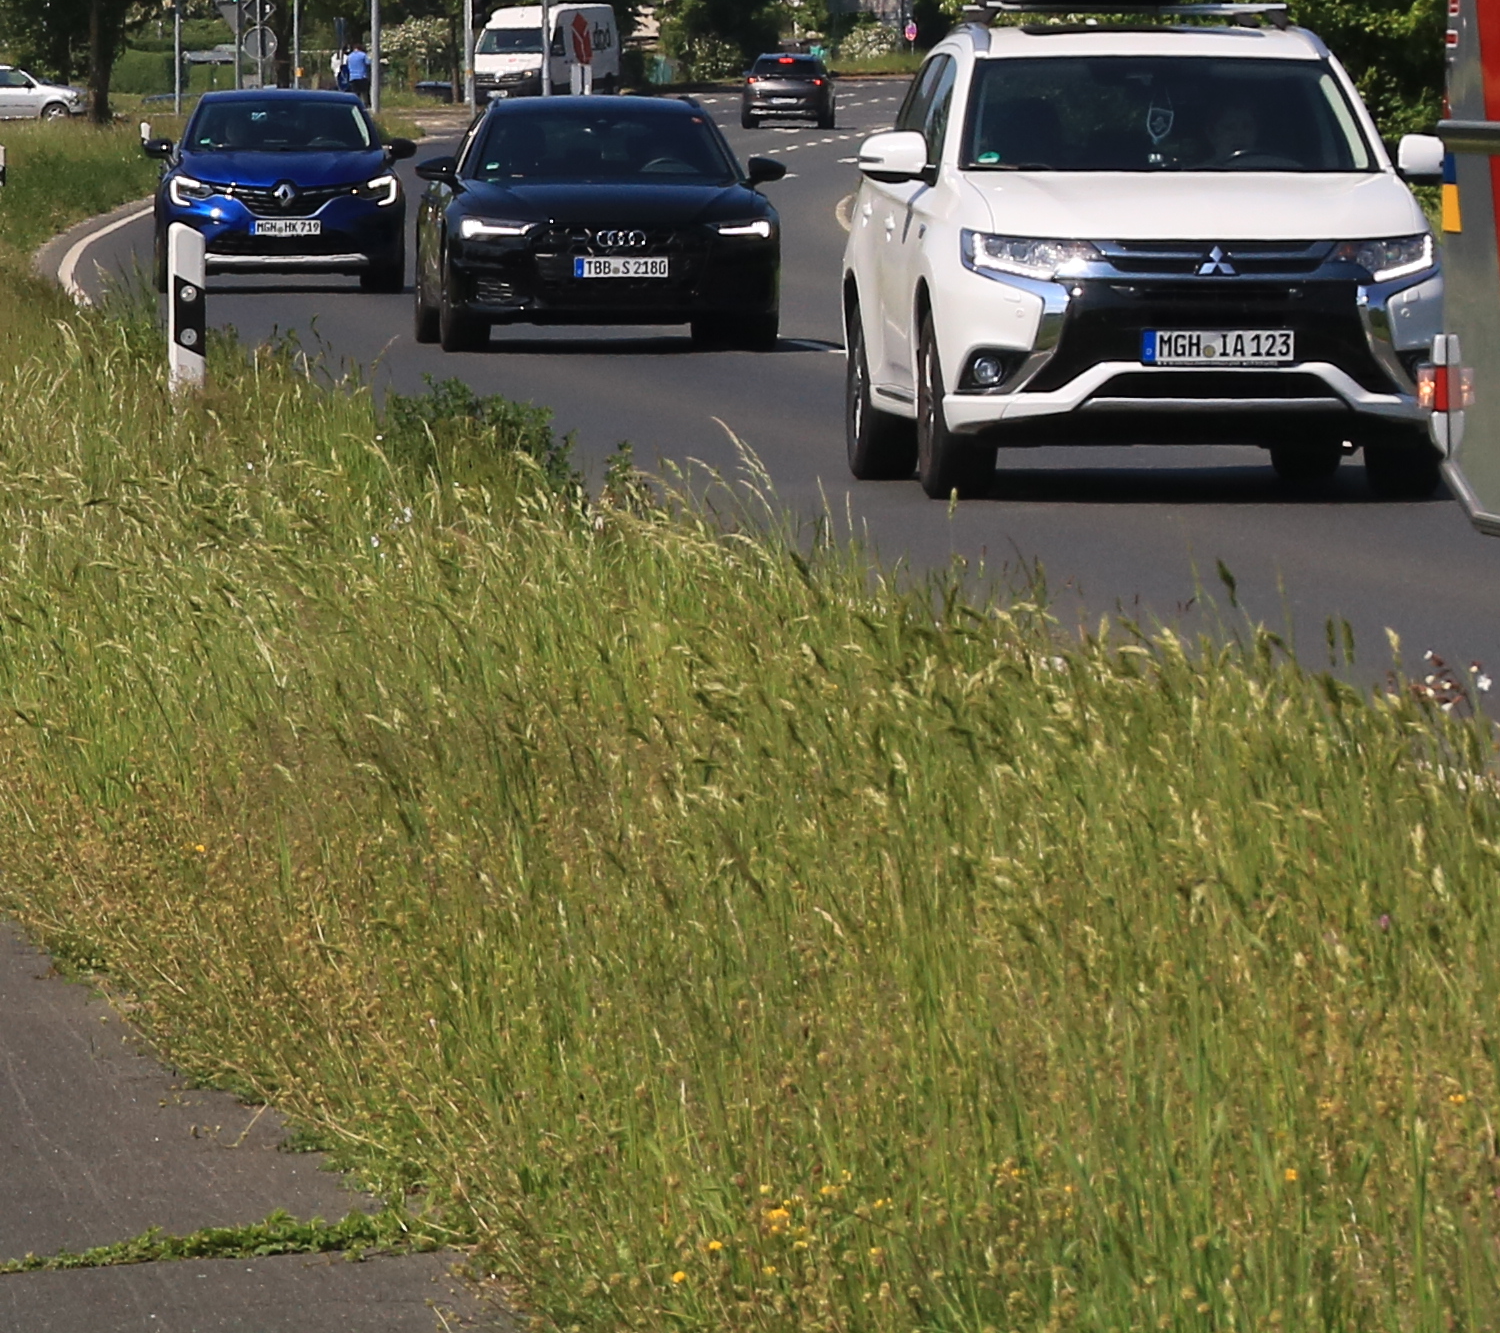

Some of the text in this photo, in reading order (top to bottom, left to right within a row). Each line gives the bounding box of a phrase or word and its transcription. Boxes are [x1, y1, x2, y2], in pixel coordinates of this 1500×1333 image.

[300, 221, 320, 233] 719
[586, 260, 667, 275] TBB S 2180
[1159, 334, 1201, 357] MGH
[1220, 334, 1246, 357] IA
[1251, 334, 1291, 357] 123
